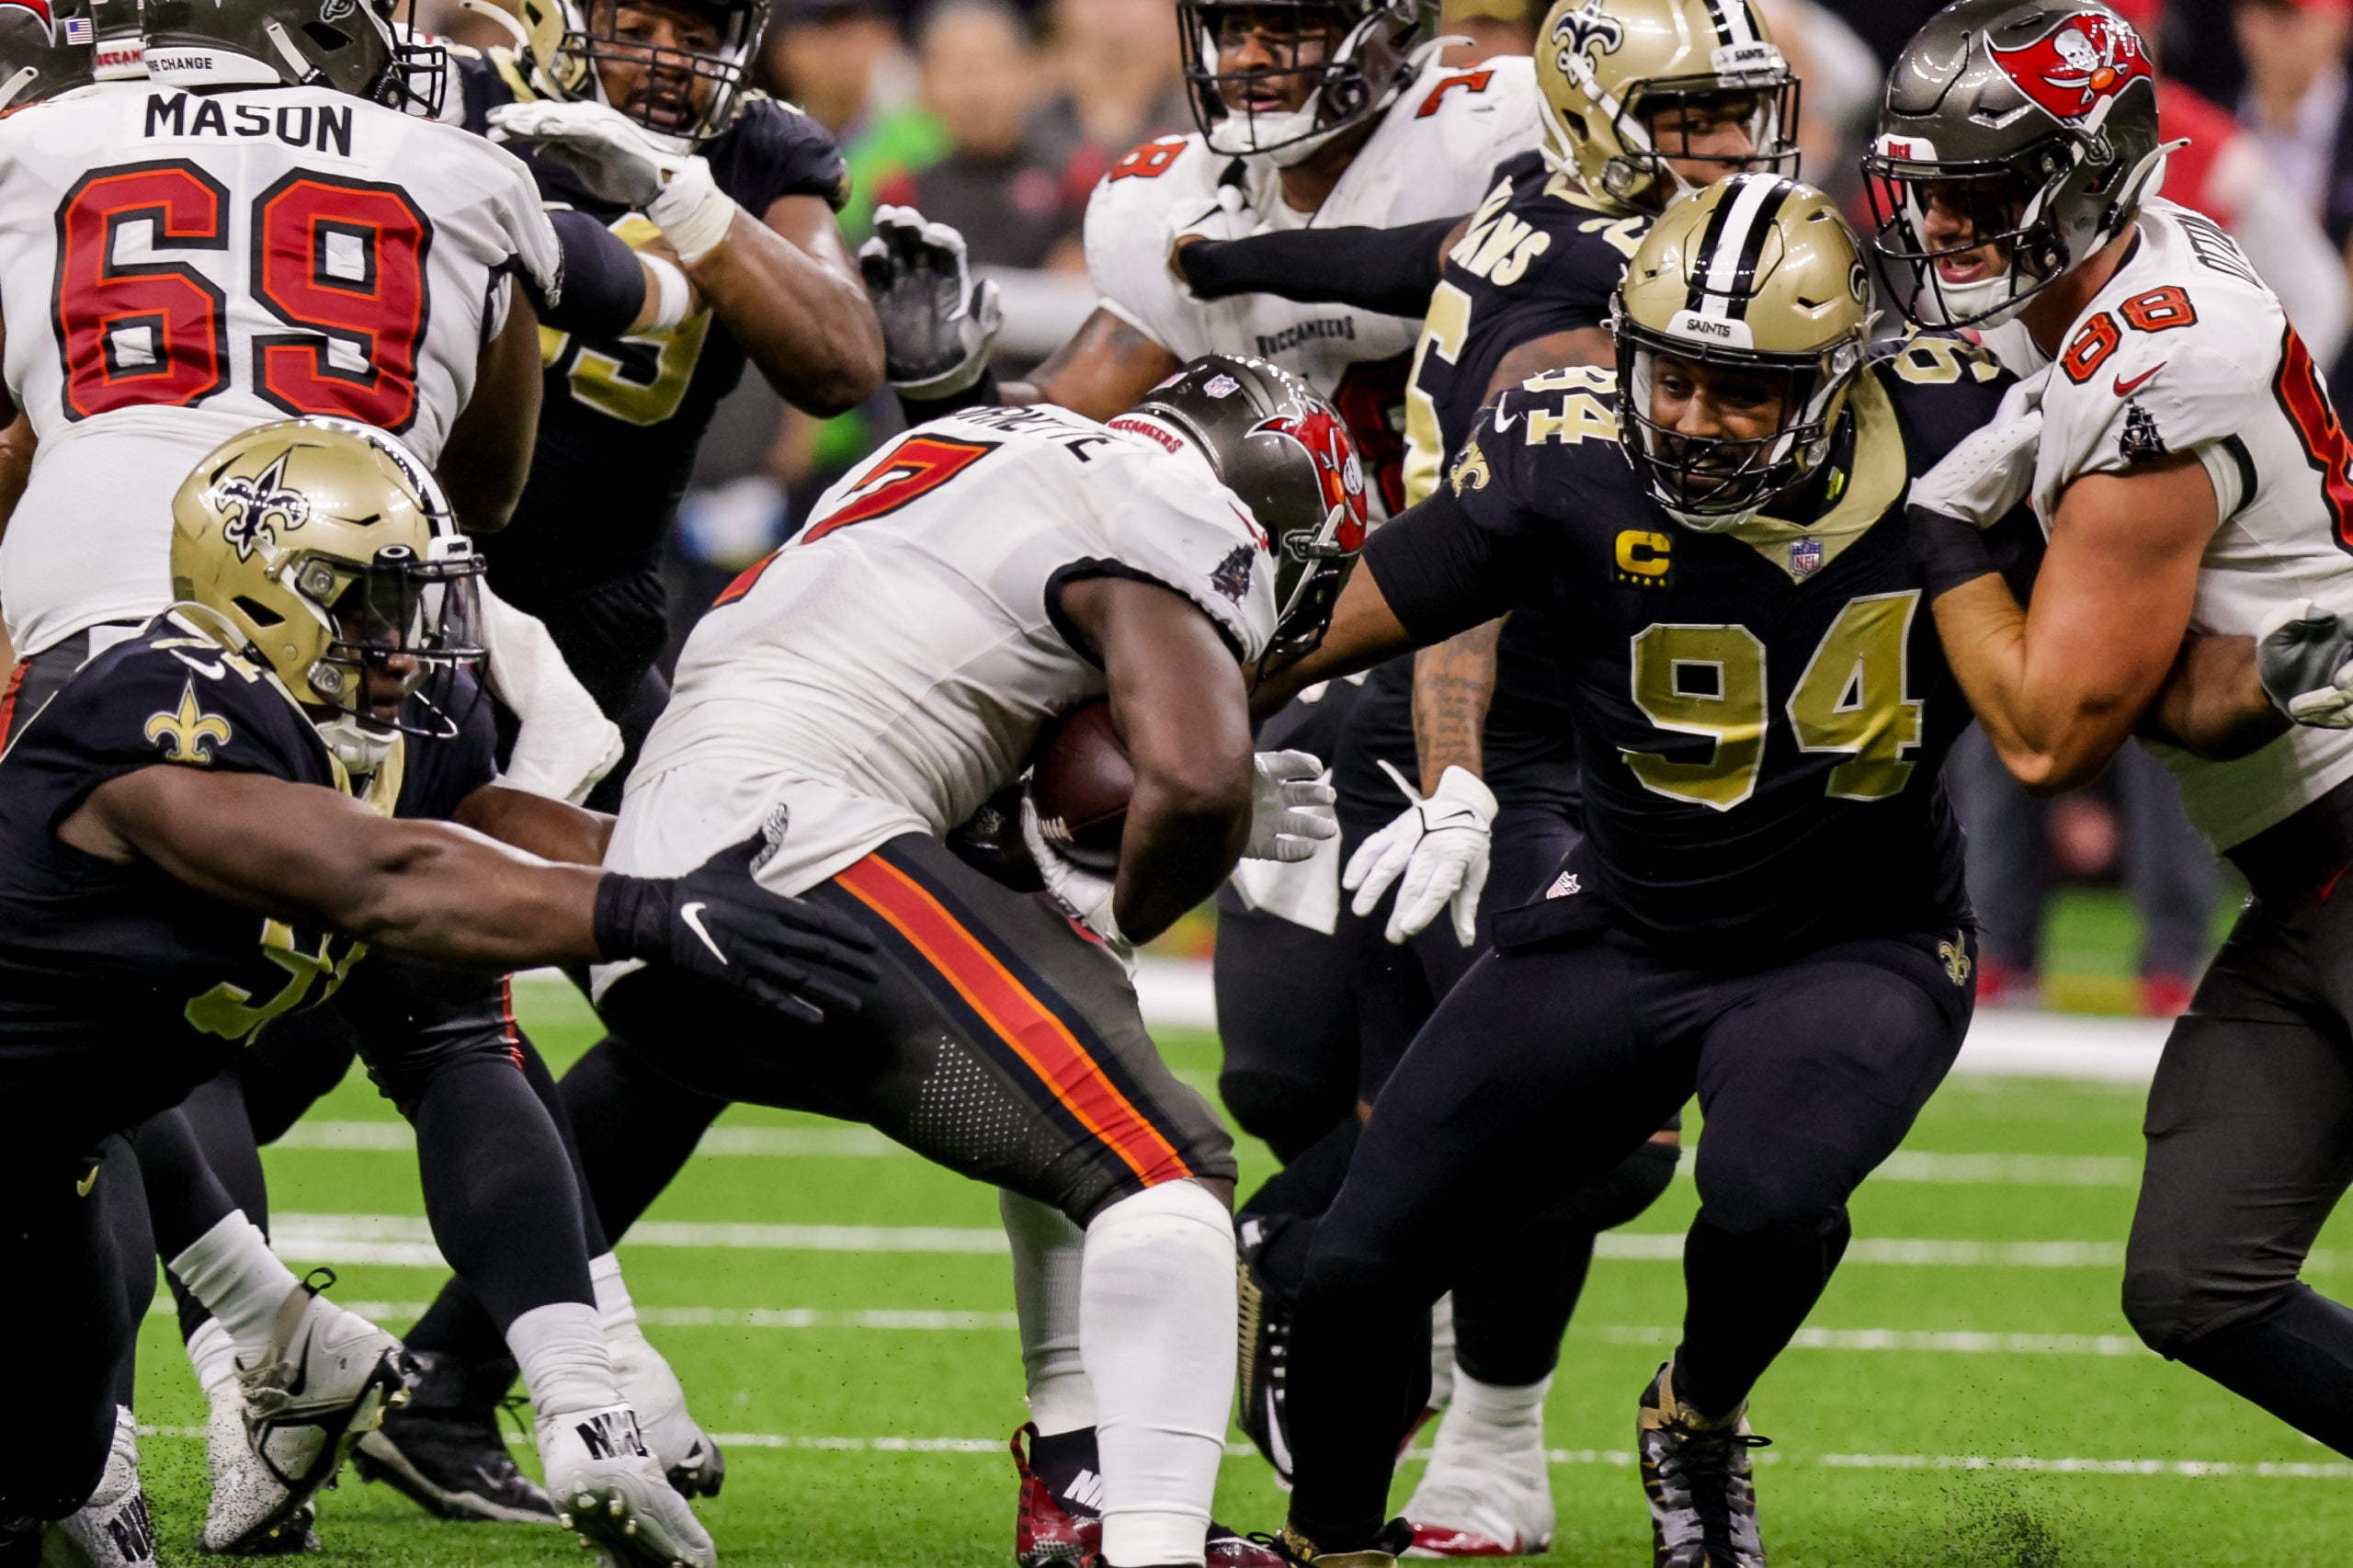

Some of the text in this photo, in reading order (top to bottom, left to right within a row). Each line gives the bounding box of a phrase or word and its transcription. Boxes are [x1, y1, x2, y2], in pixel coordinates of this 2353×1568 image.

[161, 57, 212, 72] CHANGE
[144, 92, 352, 157] MASON
[52, 158, 434, 435] 69
[1687, 319, 1731, 337] SAINTS
[2059, 285, 2200, 386] 88
[1615, 529, 1671, 576] C
[1618, 589, 1925, 812] 94
